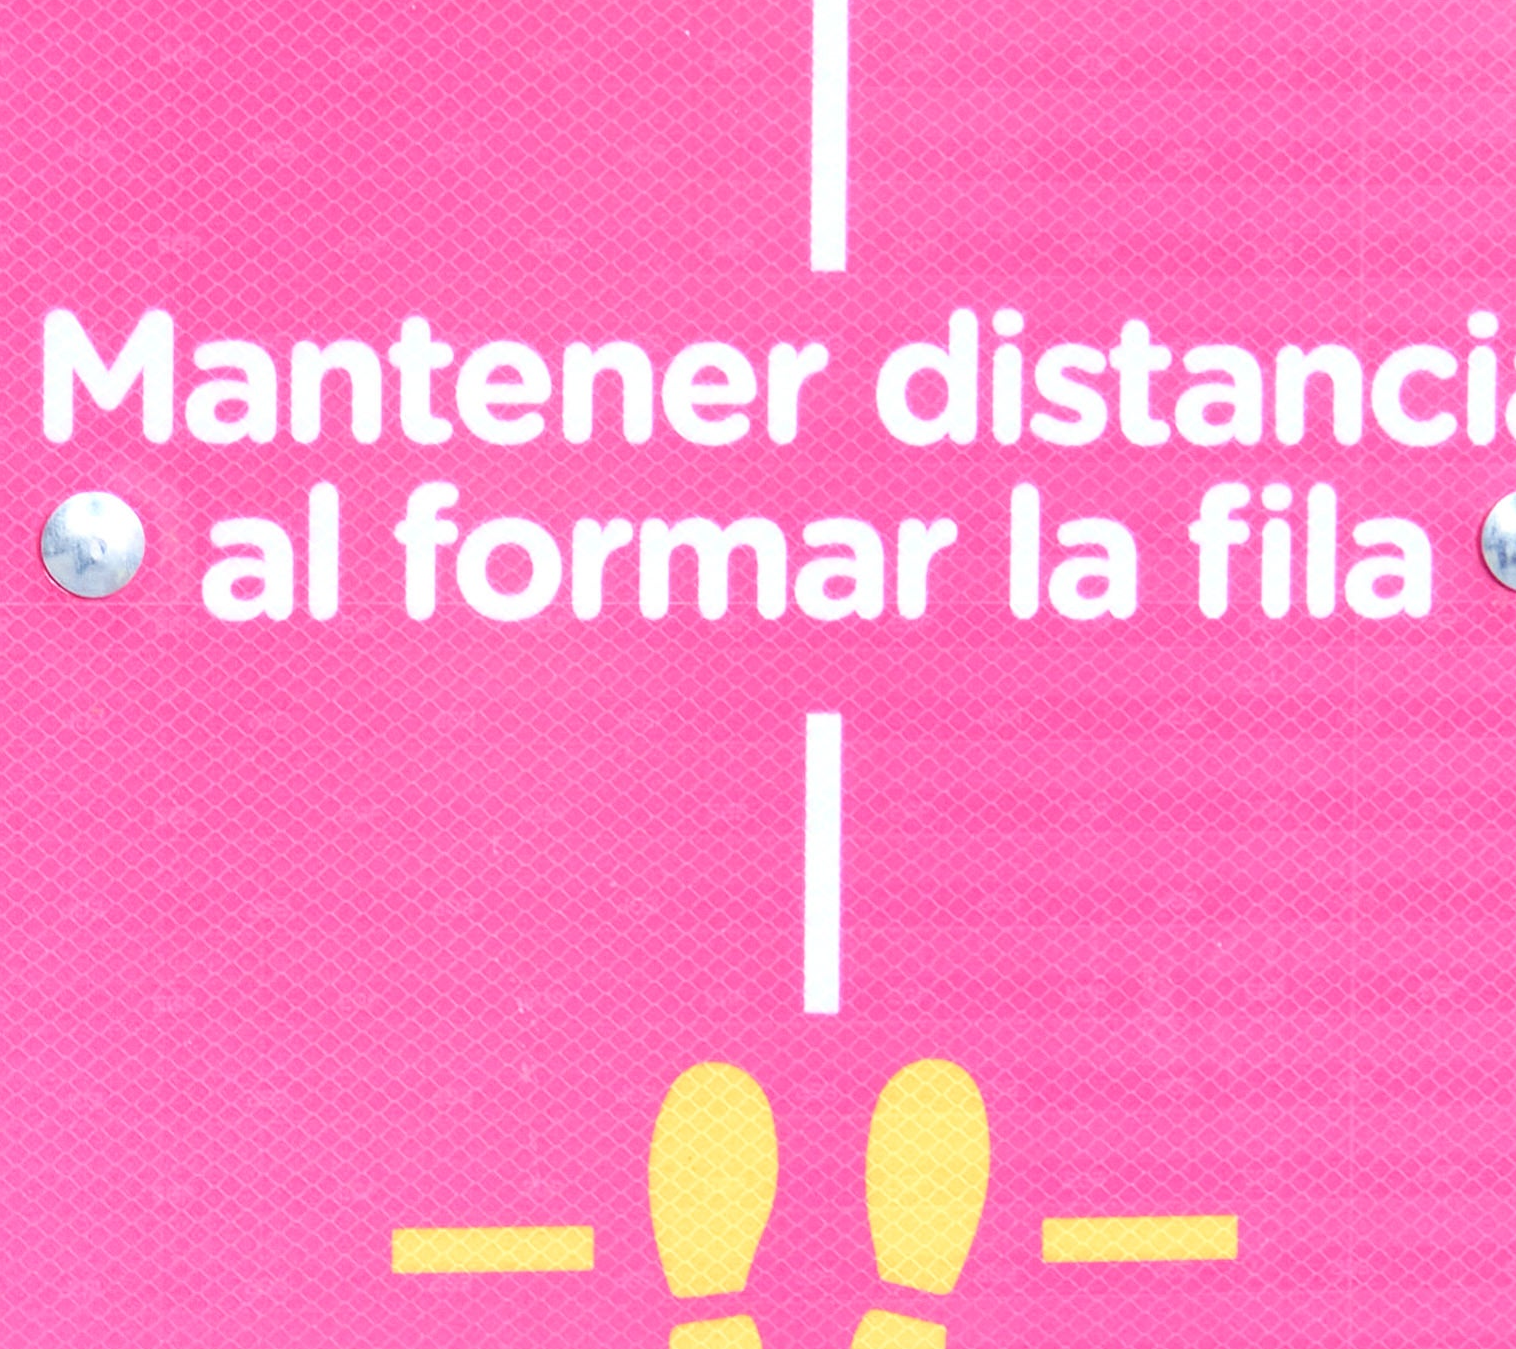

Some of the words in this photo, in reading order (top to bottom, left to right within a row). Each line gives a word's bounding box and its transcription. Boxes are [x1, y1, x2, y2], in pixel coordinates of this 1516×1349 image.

[41, 308, 829, 447] Mantener
[201, 481, 340, 622] al
[393, 481, 958, 623] formar
[1009, 482, 1138, 621] la
[1188, 481, 1433, 620] fila
